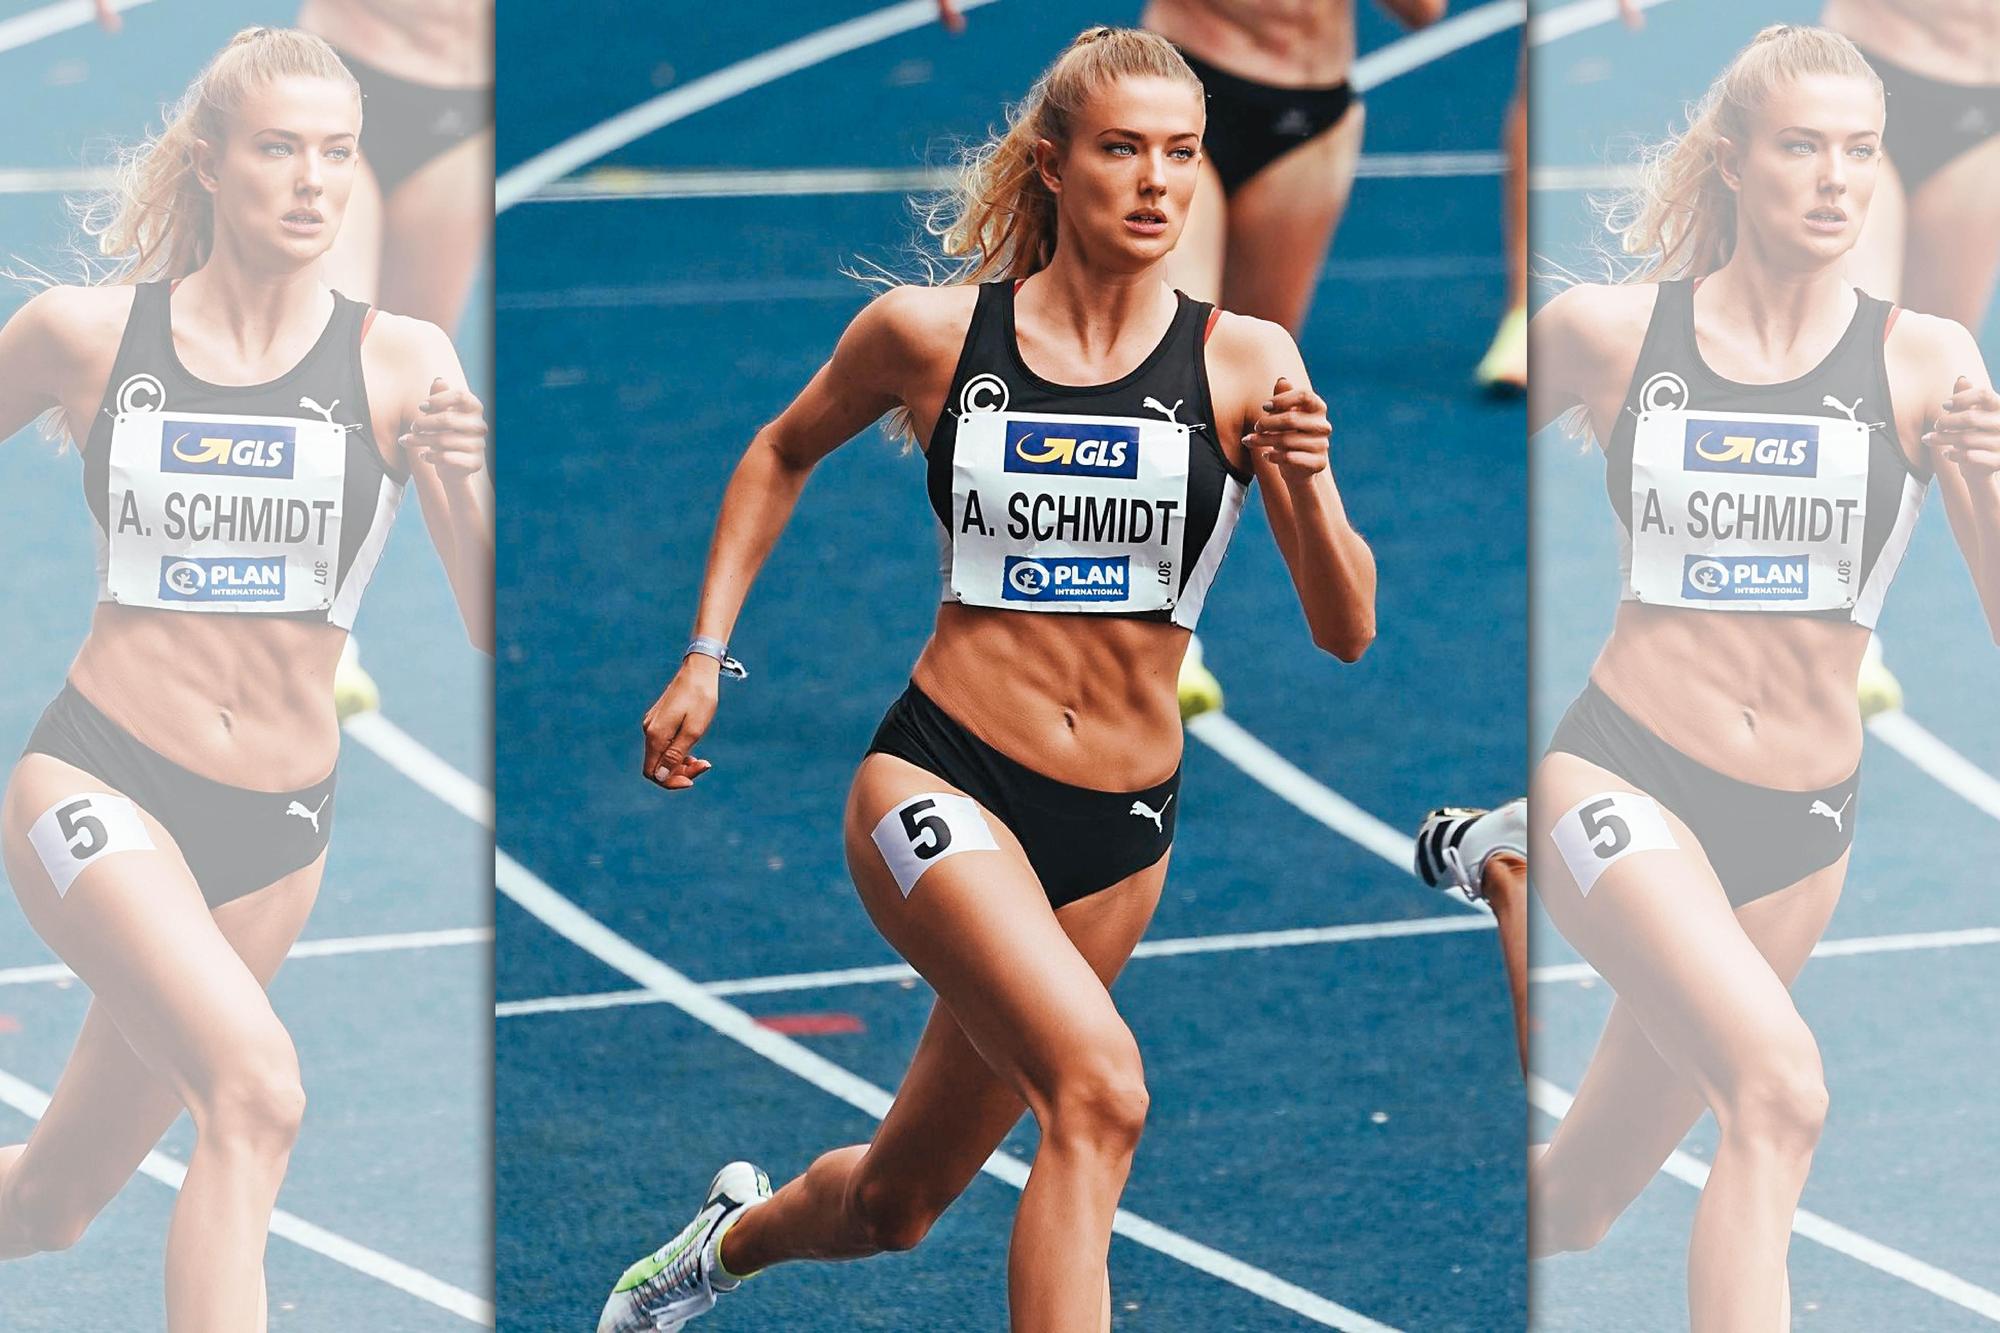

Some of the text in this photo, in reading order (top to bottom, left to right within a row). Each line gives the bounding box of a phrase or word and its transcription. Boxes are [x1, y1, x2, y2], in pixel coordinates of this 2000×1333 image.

[232, 439, 284, 467] GLS
[1075, 439, 1128, 467] GLS
[1754, 438, 1808, 466] GLS
[118, 489, 334, 545] A. SCHMIDT
[961, 489, 1178, 545] A. SCHMIDT
[1640, 488, 1858, 544] A. SCHMIDT
[212, 565, 280, 586] PLAN
[1055, 565, 1123, 586] PLAN
[1158, 561, 1171, 586] 307
[1734, 564, 1802, 585] PLAN
[1838, 560, 1850, 585] 307
[212, 588, 280, 596] INTERNATIONAL
[1055, 588, 1123, 596] INTERNATIONAL
[1734, 587, 1802, 595] INTERNATIONAL
[56, 798, 108, 860] 5
[899, 798, 952, 860] 5
[1578, 797, 1631, 859] 5
